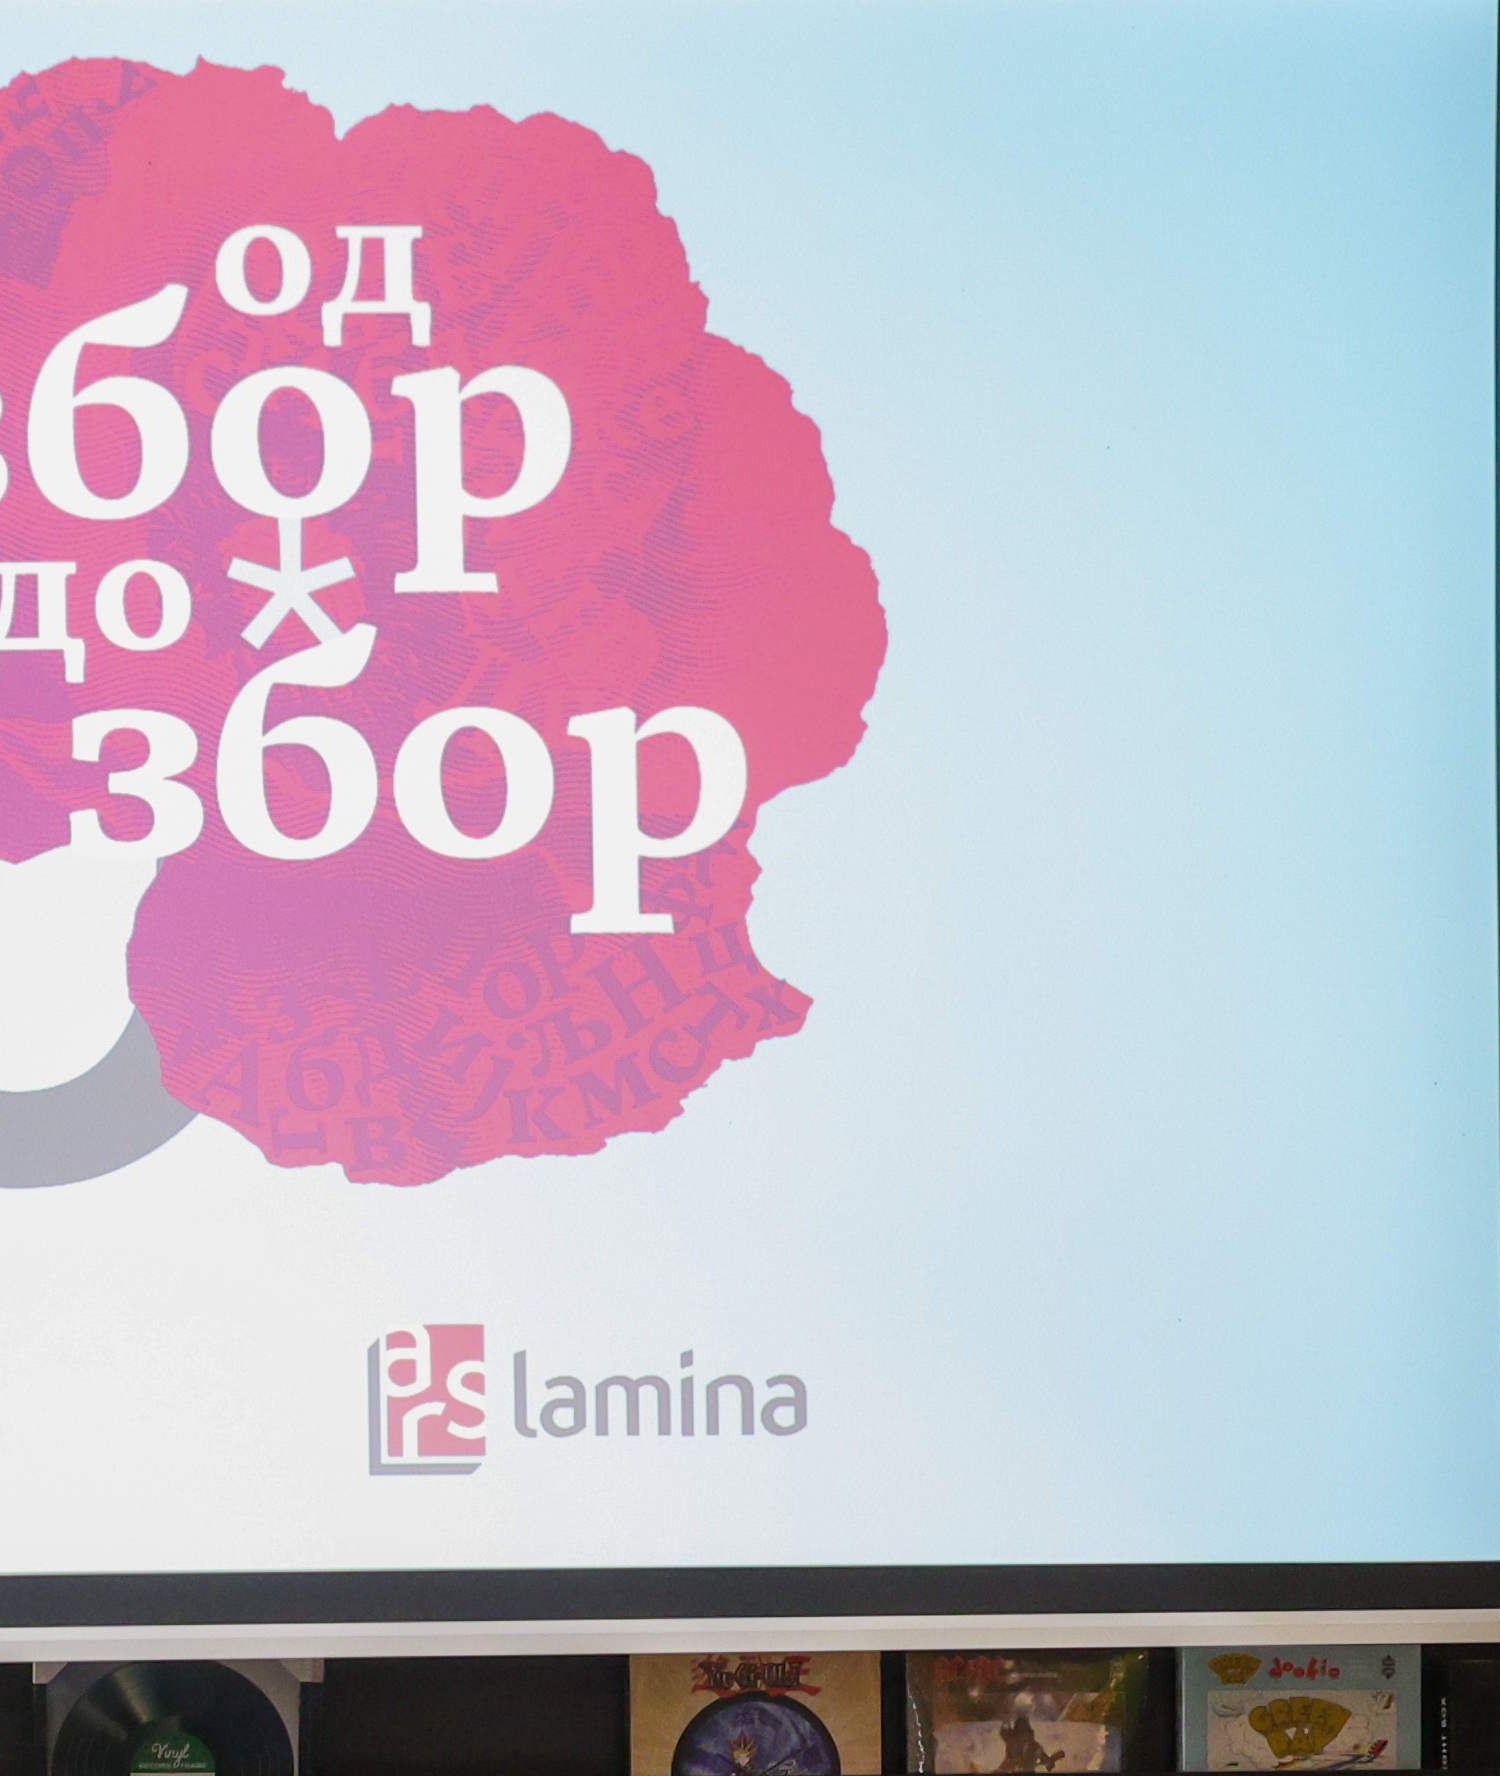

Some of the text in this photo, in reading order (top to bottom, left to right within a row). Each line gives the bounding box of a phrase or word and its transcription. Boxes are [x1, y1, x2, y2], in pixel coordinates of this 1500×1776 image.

[213, 222, 432, 345] од
[67, 622, 750, 936] збор
[513, 1349, 808, 1438] lamina
[151, 1743, 190, 1768] Vinyl
